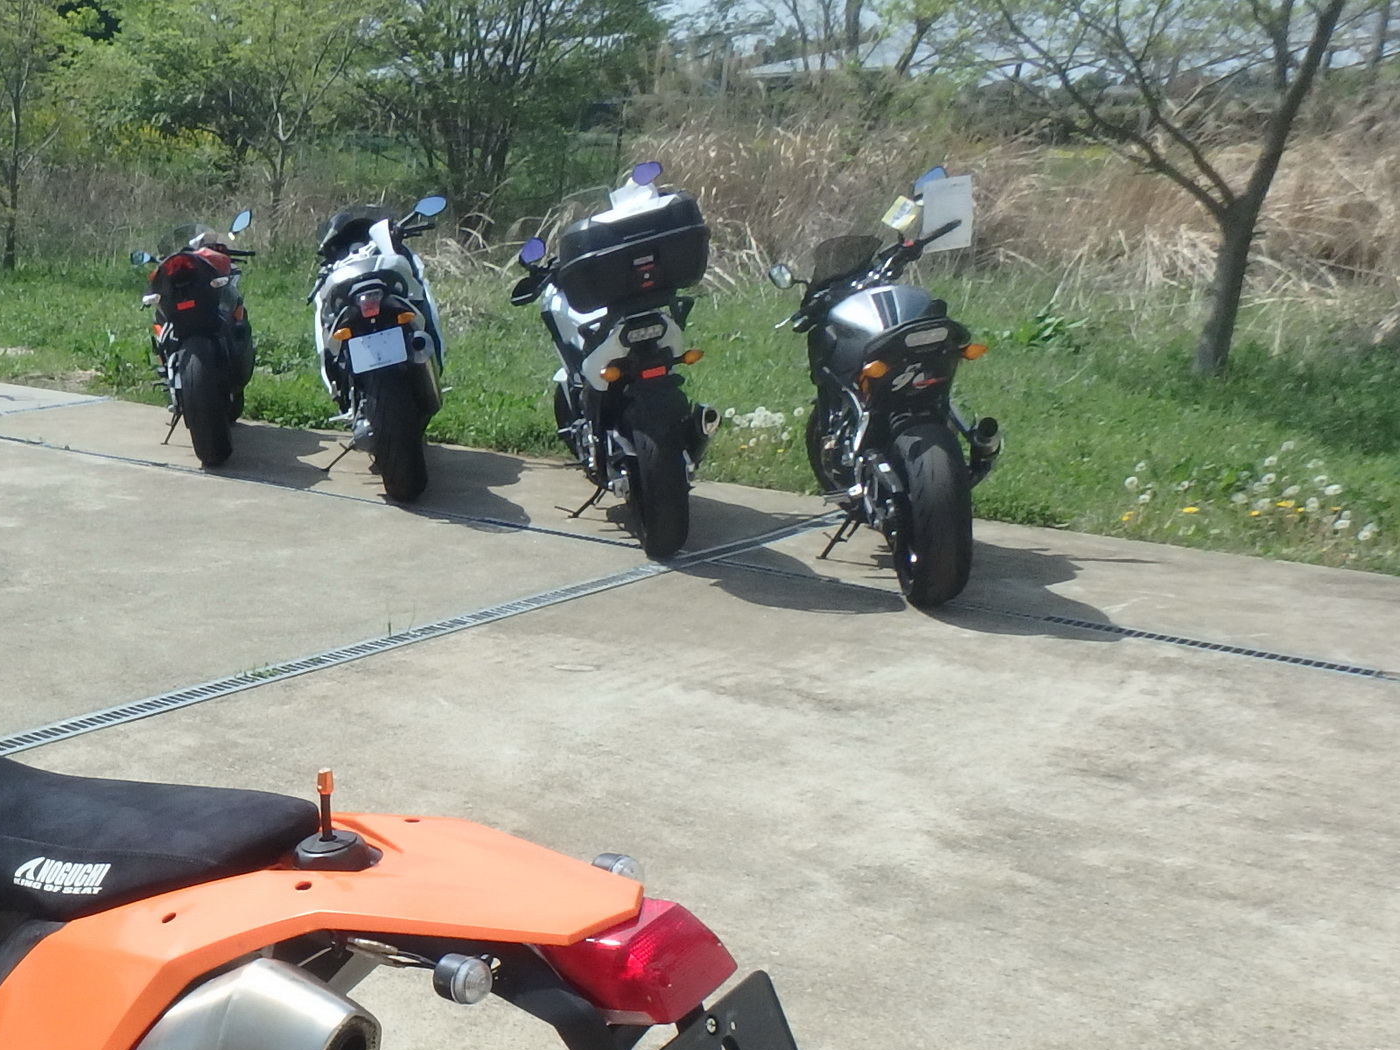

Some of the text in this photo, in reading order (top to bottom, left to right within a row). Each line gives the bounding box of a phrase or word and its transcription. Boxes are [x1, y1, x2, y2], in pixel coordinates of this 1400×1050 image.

[36, 858, 111, 887] NOGUCHI
[13, 877, 102, 894] KING OF SEAT
